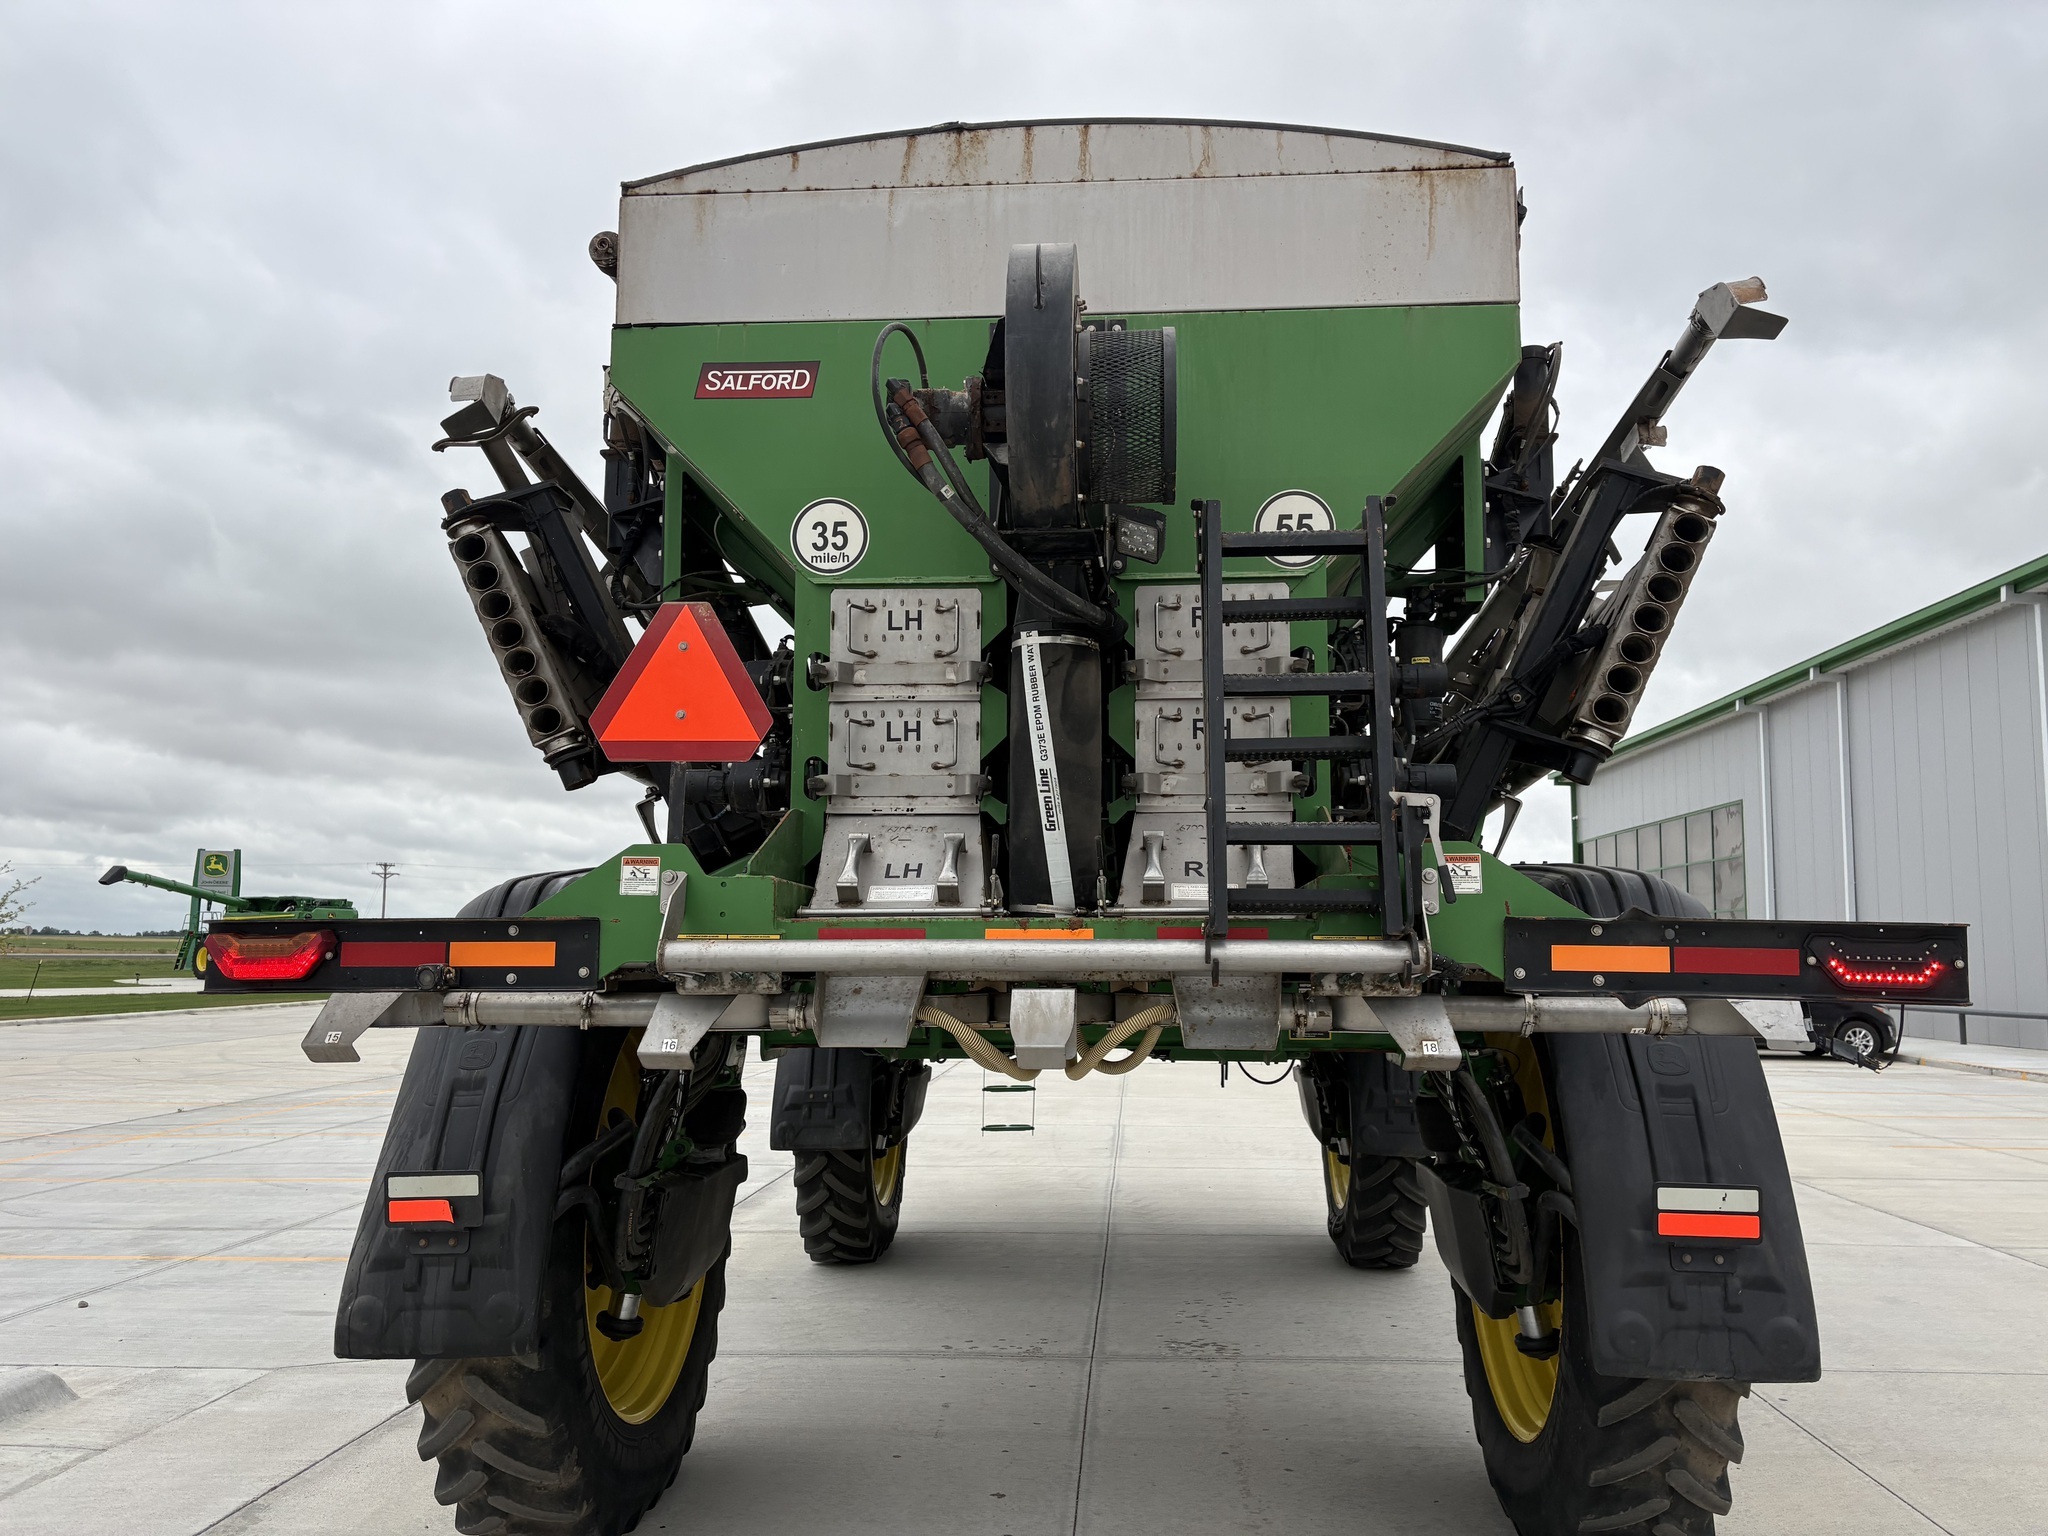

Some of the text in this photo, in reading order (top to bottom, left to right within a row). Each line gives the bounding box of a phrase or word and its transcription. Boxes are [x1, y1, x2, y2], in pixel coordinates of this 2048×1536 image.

[705, 369, 811, 391] SALFORD
[1276, 513, 1314, 533] 55
[811, 520, 849, 551] 35
[810, 551, 850, 564] mile/h
[887, 609, 922, 631] LH
[1026, 630, 1049, 762] G373E EPDM RUBBER WATR
[886, 720, 921, 742] LH
[1037, 768, 1057, 832] Green Line
[884, 863, 923, 879] LH
[327, 1032, 340, 1042] 15
[664, 1040, 676, 1050] 16
[1423, 1042, 1438, 1053] 18
